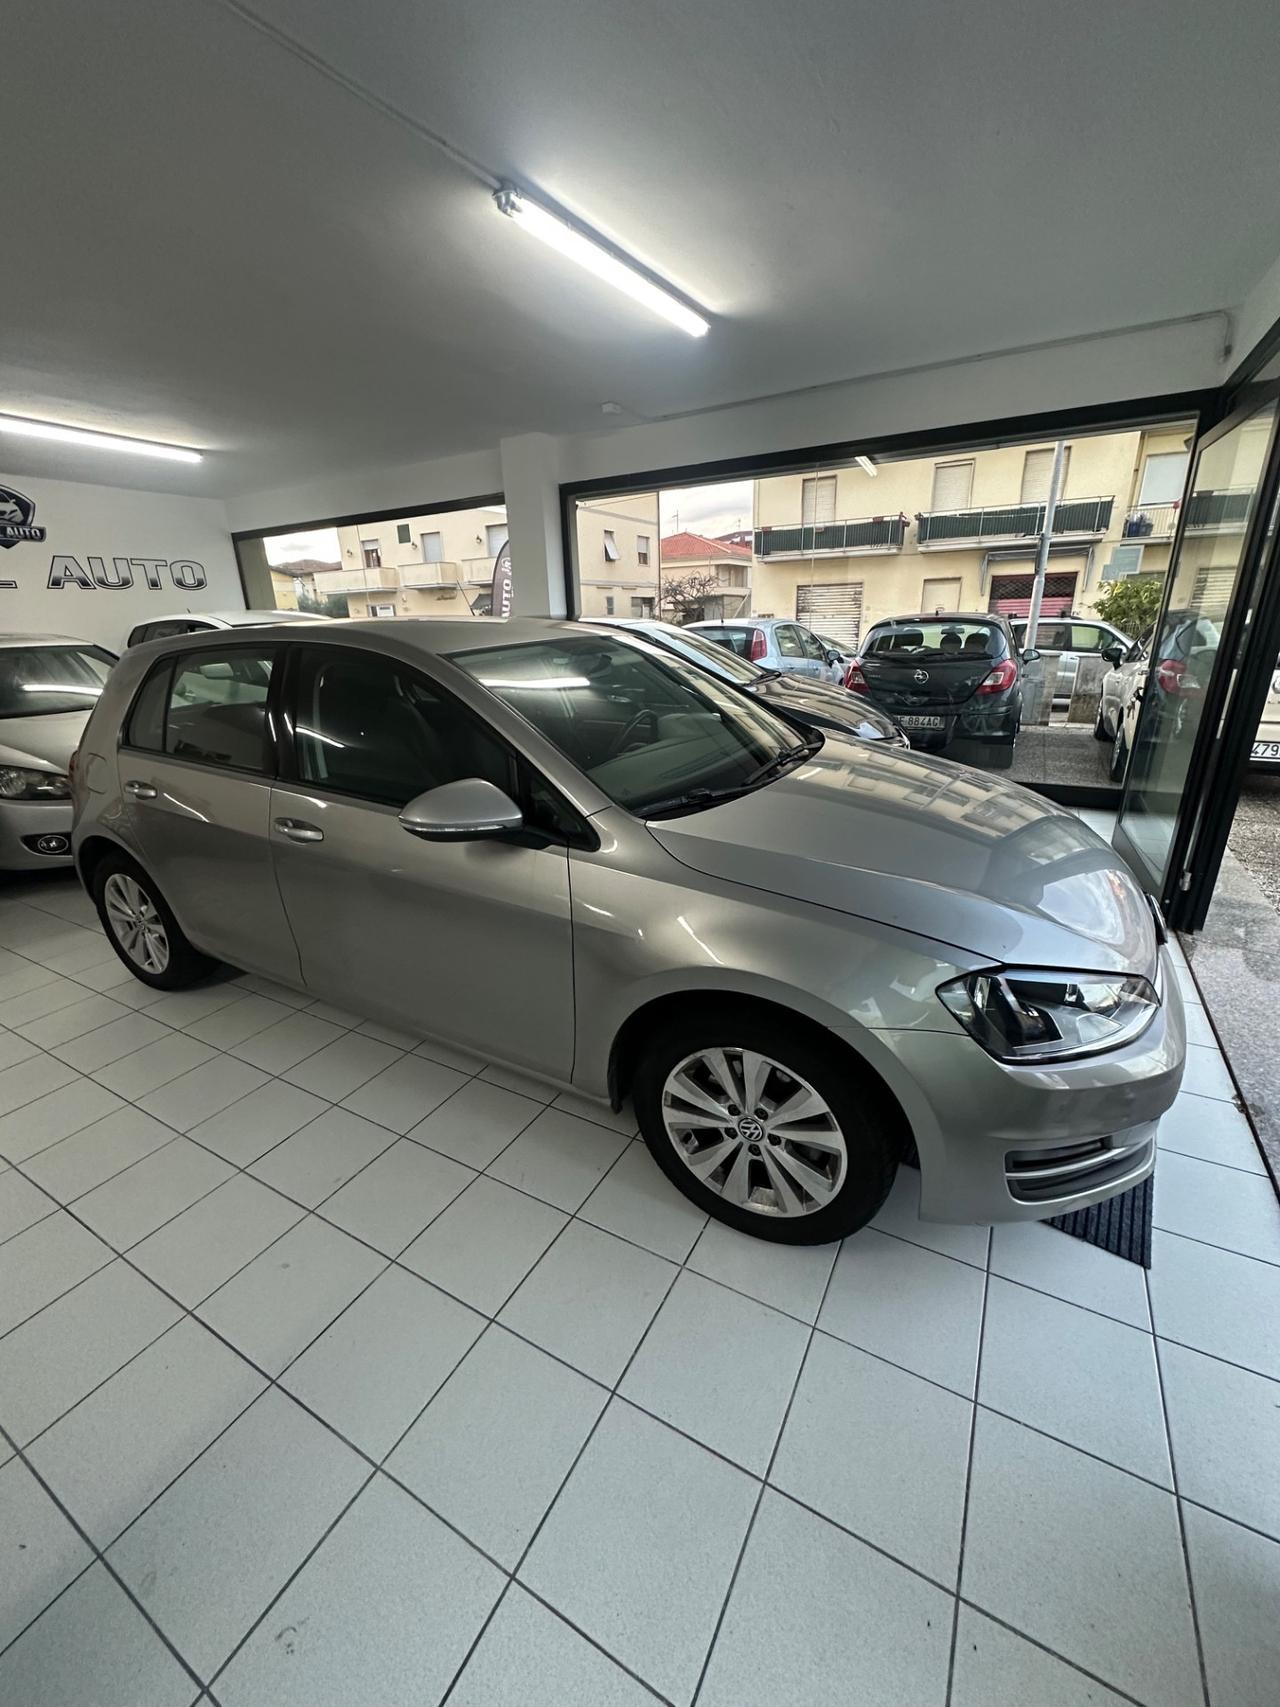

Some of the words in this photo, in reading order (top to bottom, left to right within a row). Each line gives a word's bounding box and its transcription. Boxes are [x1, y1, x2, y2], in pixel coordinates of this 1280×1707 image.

[6, 526, 41, 538] AUTO
[47, 555, 208, 591] AUTO
[1252, 743, 1280, 756] 479
